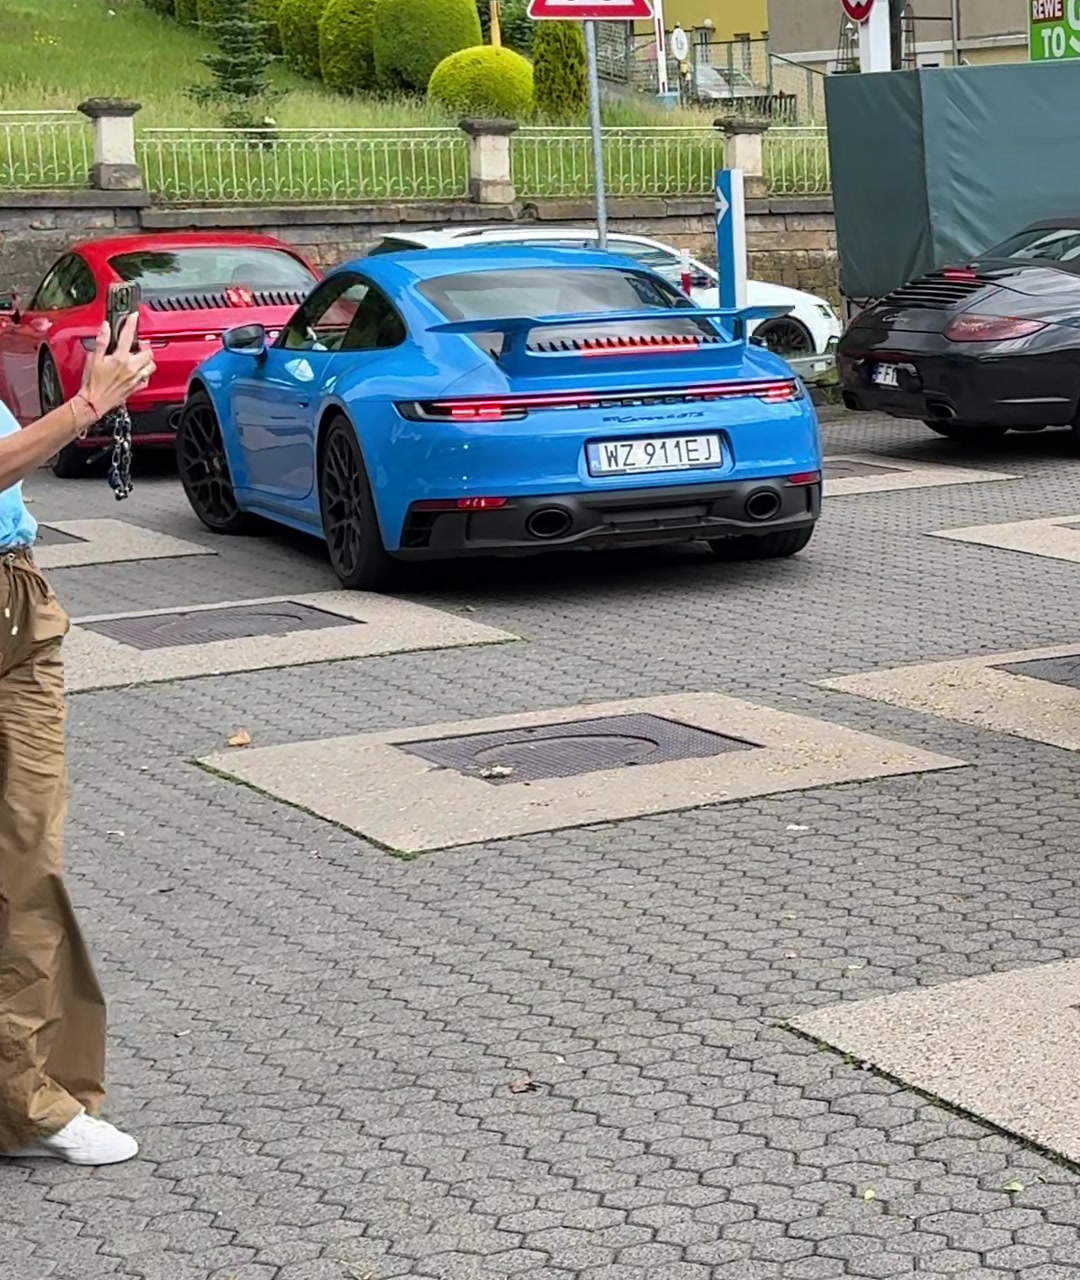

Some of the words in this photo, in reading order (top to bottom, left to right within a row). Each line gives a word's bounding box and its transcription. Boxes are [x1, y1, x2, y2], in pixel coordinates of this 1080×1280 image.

[1041, 26, 1066, 58] TO
[604, 443, 636, 468] WZ
[643, 438, 712, 465] 911EJ
